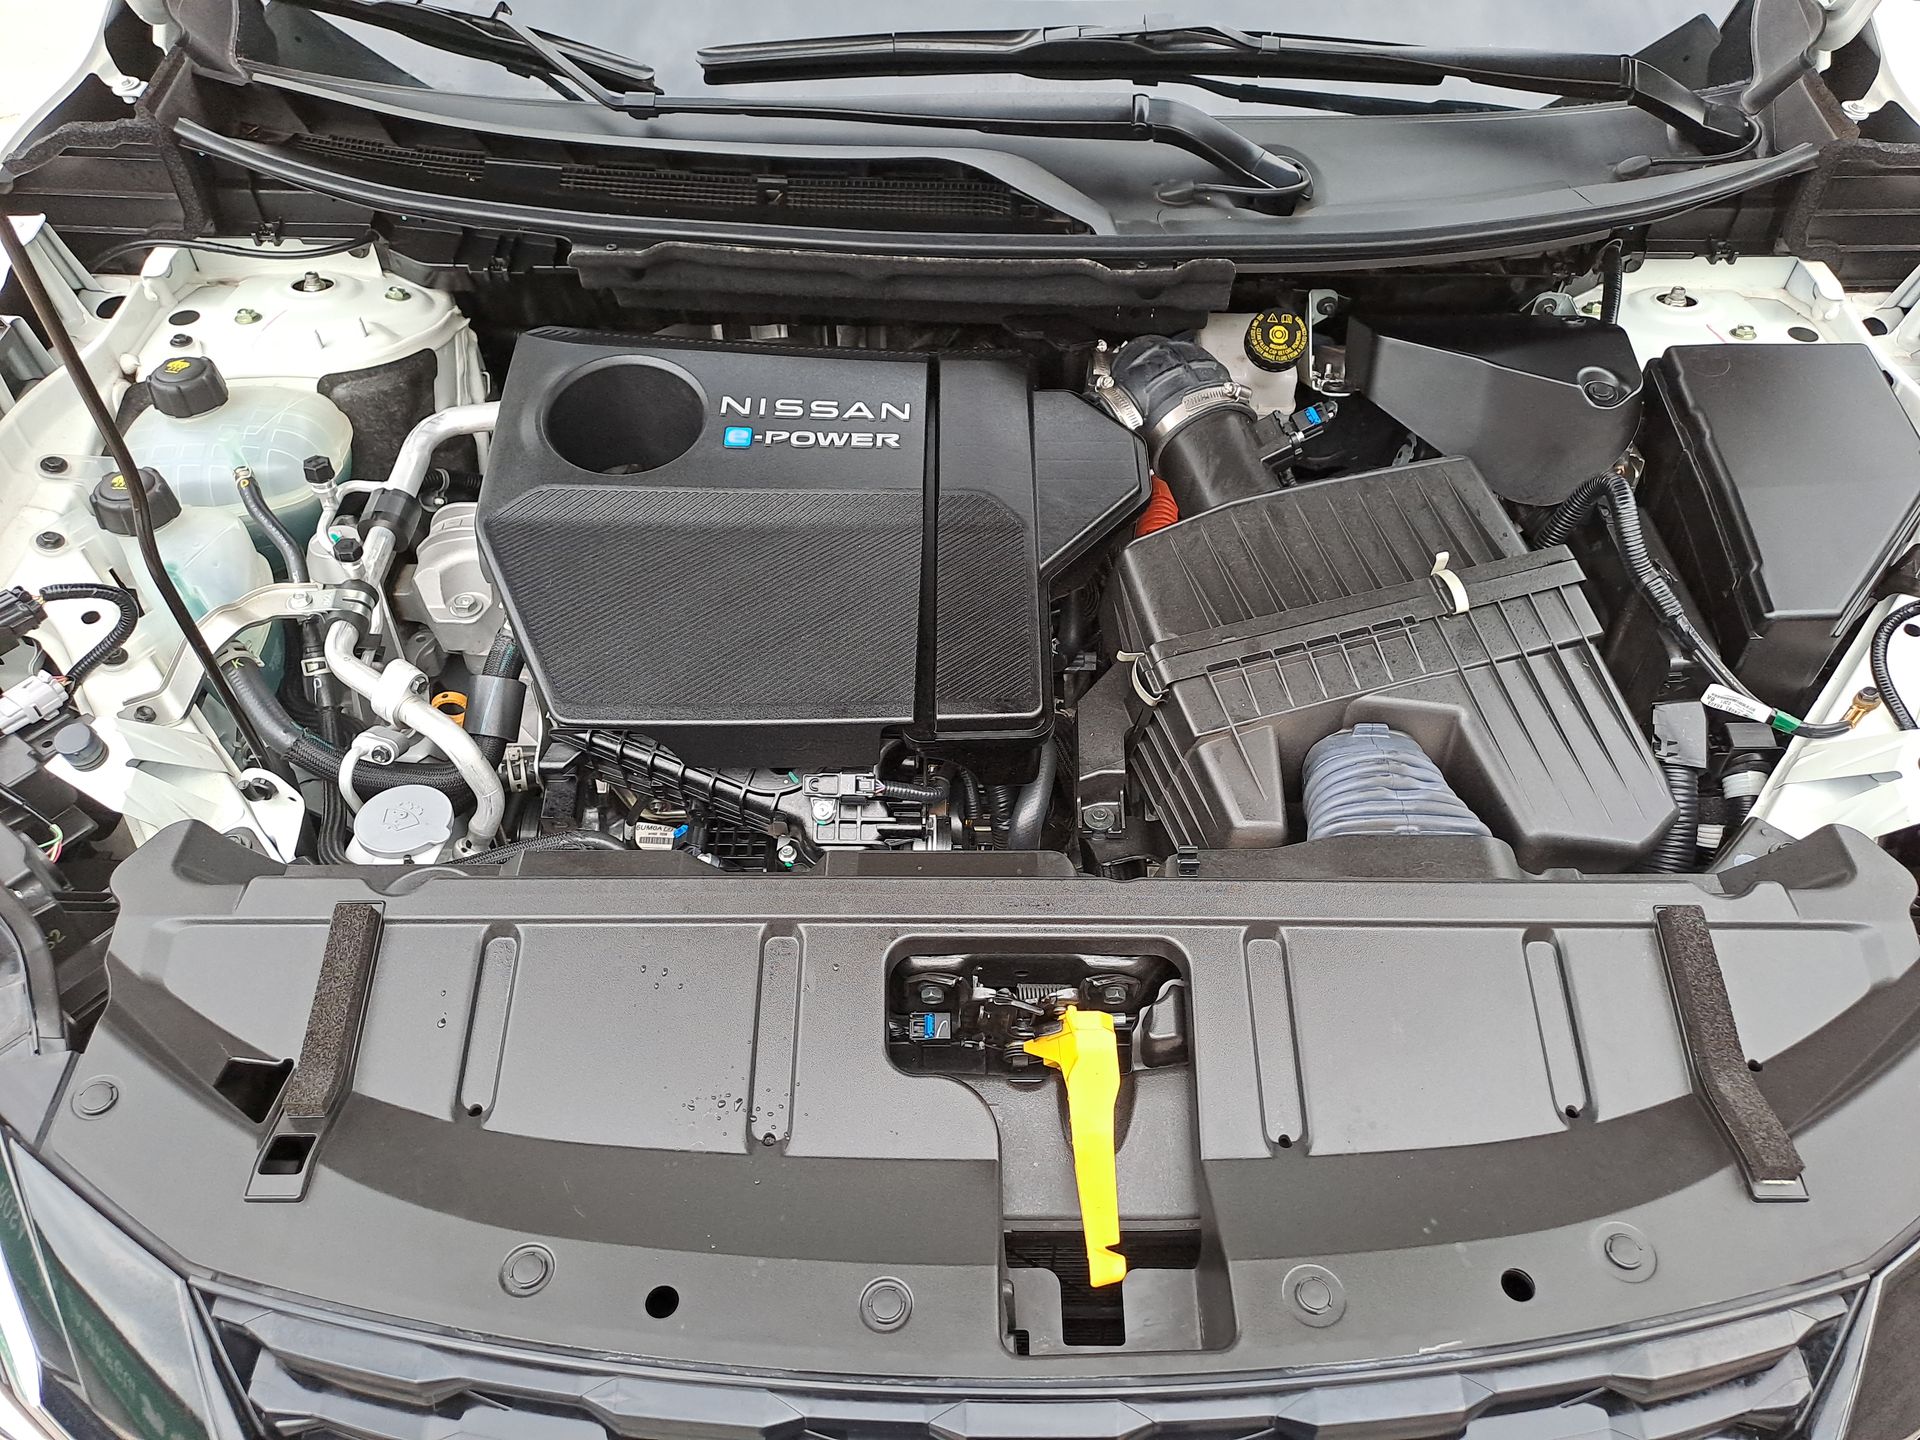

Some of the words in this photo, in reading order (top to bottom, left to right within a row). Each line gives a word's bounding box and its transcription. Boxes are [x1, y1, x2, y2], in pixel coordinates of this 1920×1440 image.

[720, 396, 911, 422] NISSAN
[723, 426, 901, 449] e-POWER
[231, 658, 245, 669] K
